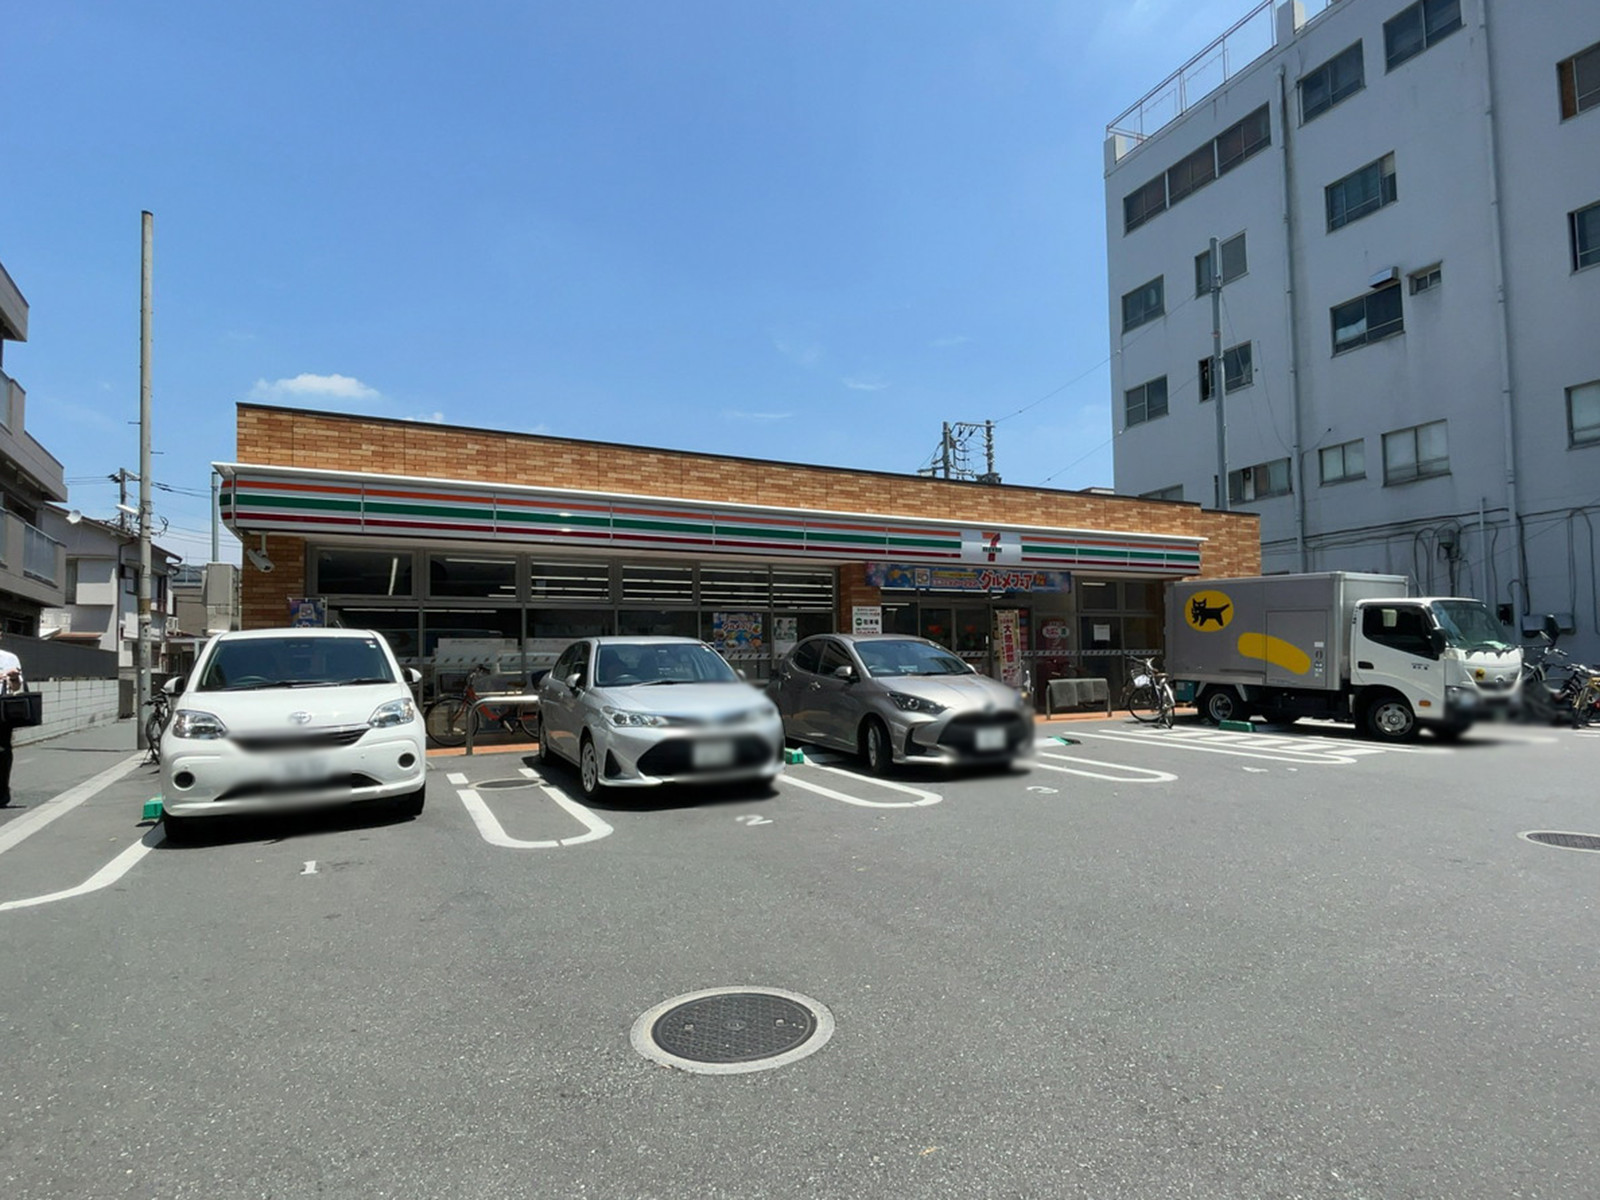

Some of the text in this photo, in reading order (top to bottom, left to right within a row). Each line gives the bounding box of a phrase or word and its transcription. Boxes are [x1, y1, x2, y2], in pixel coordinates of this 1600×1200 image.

[980, 571, 1033, 590] グルメフェア
[735, 814, 773, 826] 2
[300, 860, 318, 875] 1
